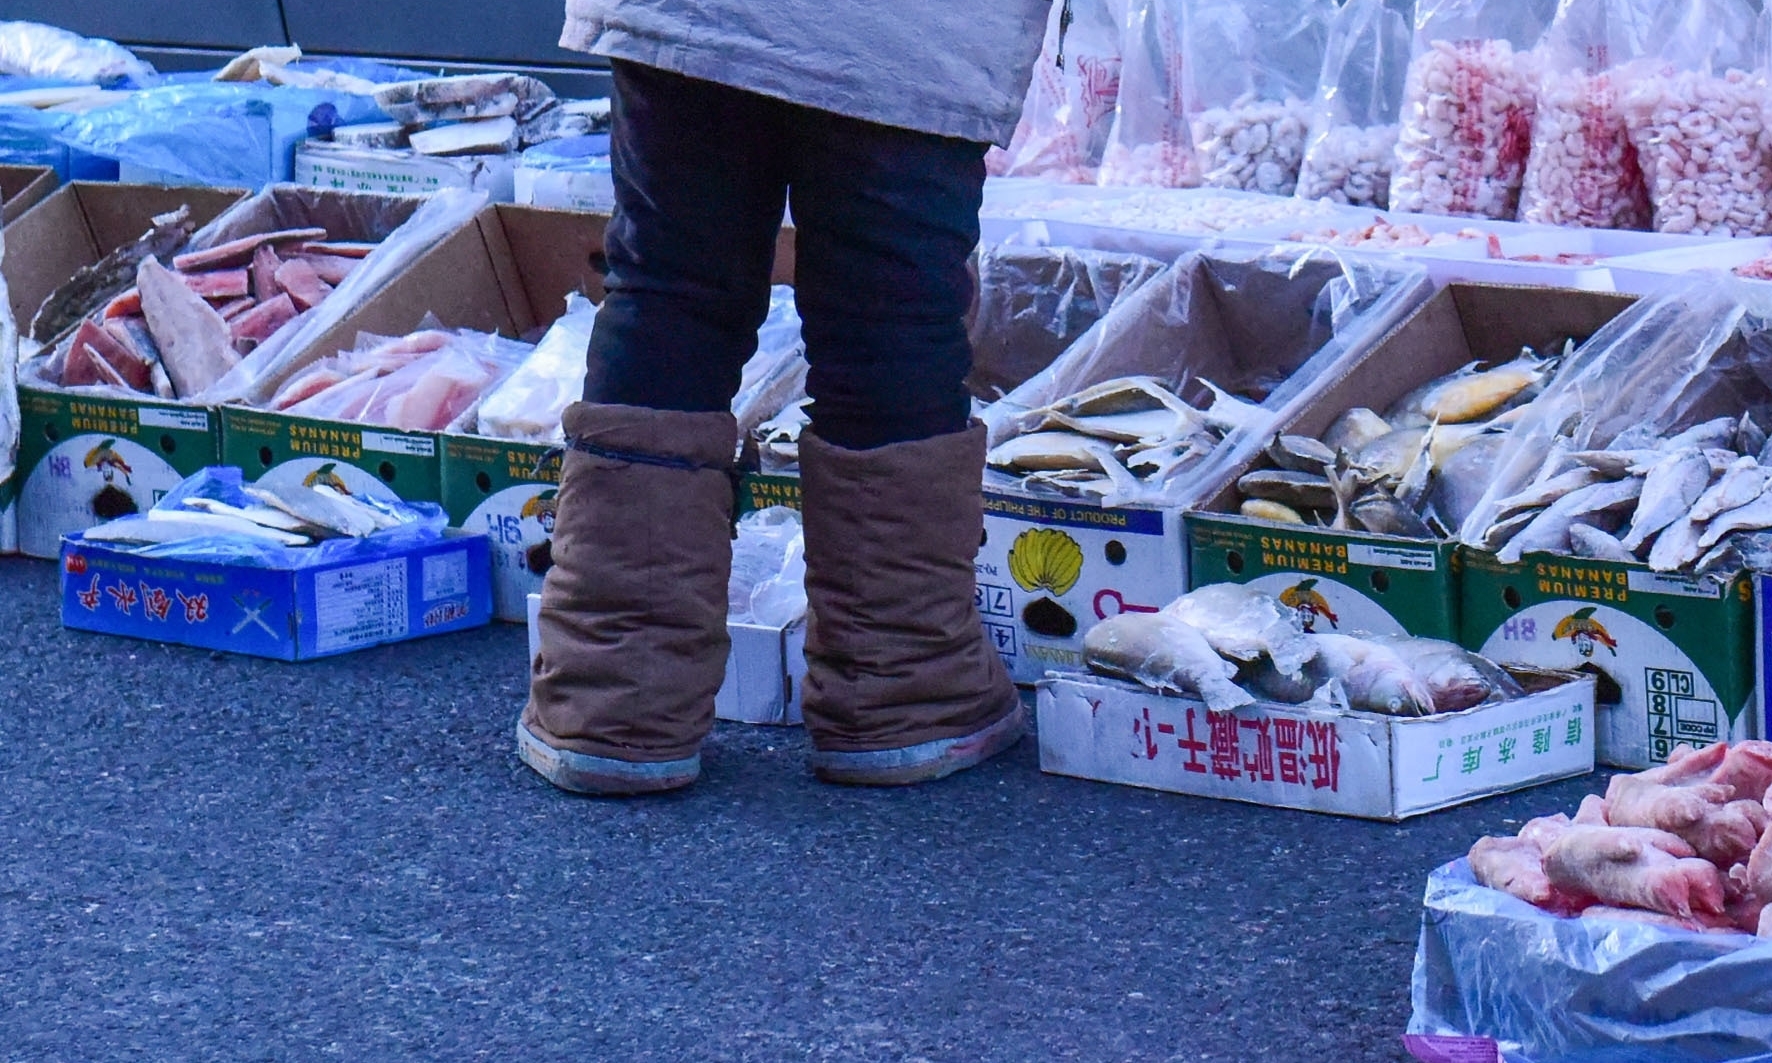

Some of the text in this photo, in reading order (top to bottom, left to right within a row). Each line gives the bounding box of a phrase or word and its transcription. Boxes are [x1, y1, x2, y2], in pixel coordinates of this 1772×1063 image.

[69, 402, 138, 421] BANANAS
[71, 417, 138, 435] PREMIUM
[288, 424, 362, 444] BANANAS
[290, 437, 362, 459] PREMIUM
[1027, 505, 1046, 518] THE
[1051, 508, 1066, 518] OF
[1070, 511, 1126, 526] PRODUCT
[1260, 535, 1347, 559] BANANAS
[1262, 553, 1347, 575] PREMIUM
[1536, 562, 1628, 586] BANANAS
[1537, 578, 1628, 602] PREMIUM
[995, 629, 1010, 647] 4
[1504, 619, 1538, 642] 8H
[1651, 670, 1692, 695] 9 CL
[1652, 692, 1667, 714] 8
[1652, 715, 1667, 736] 7
[1421, 715, 1583, 784] 信隆冻库厂
[1653, 738, 1668, 761] 6
